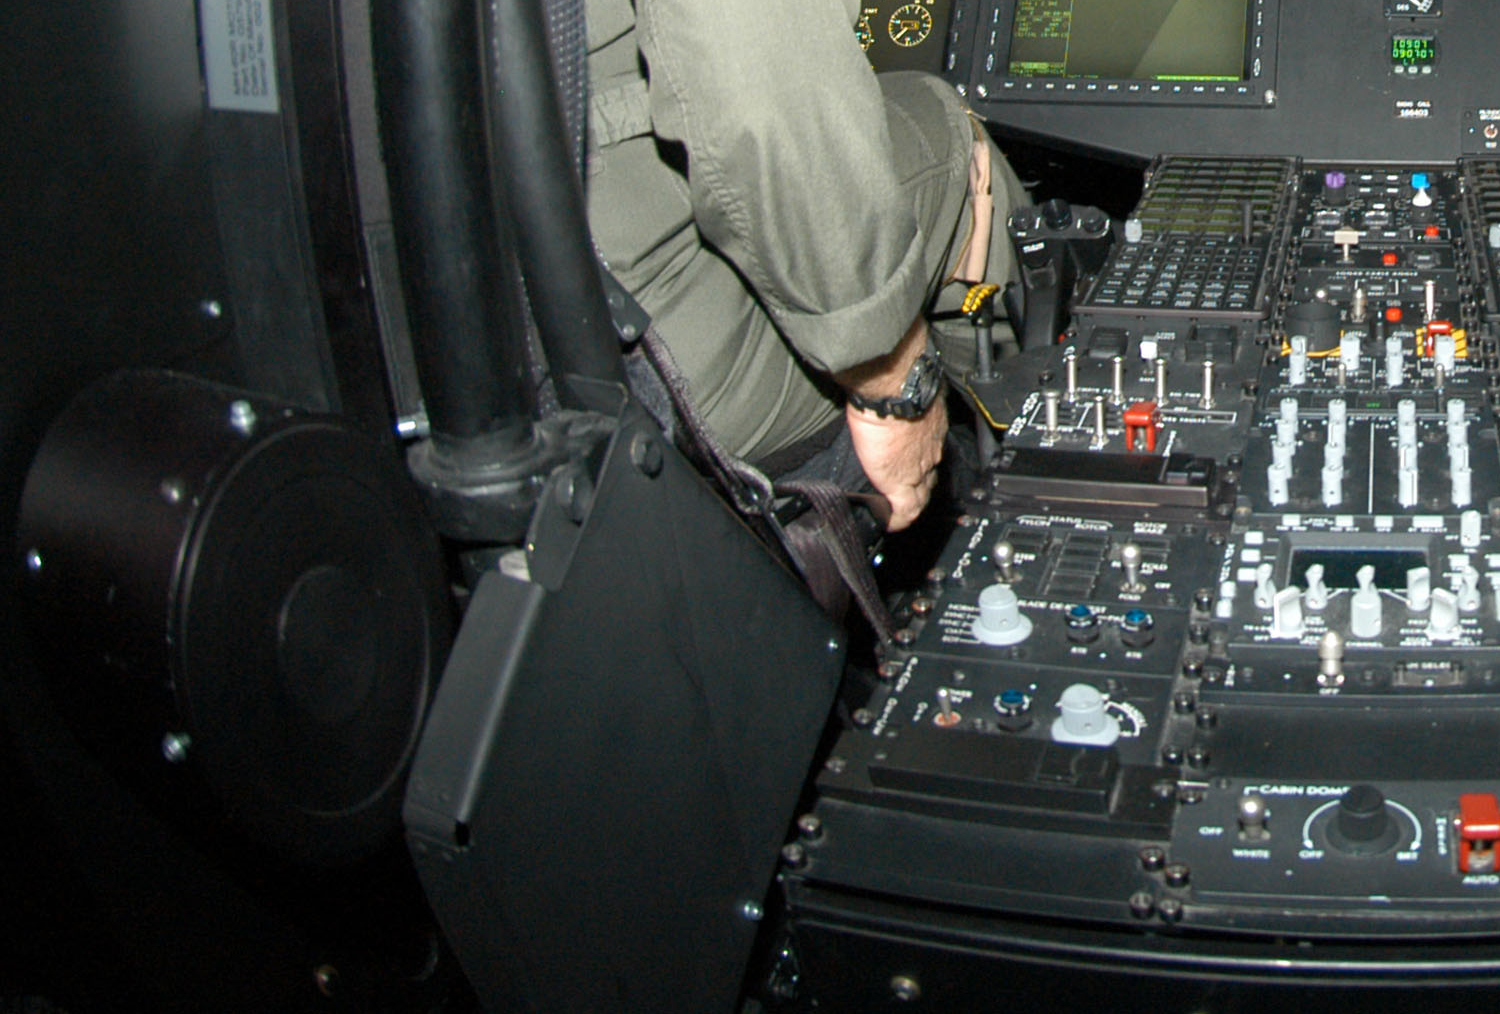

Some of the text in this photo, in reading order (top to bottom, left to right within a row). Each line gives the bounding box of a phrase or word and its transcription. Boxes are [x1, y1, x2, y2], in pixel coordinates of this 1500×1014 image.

[1074, 524, 1108, 532] ROTOR
[1259, 785, 1304, 795] CABIN
[1199, 827, 1224, 835] OFF
[1232, 849, 1271, 859] WHITE
[1299, 849, 1325, 859] OFF
[1462, 875, 1500, 885] AUTO
